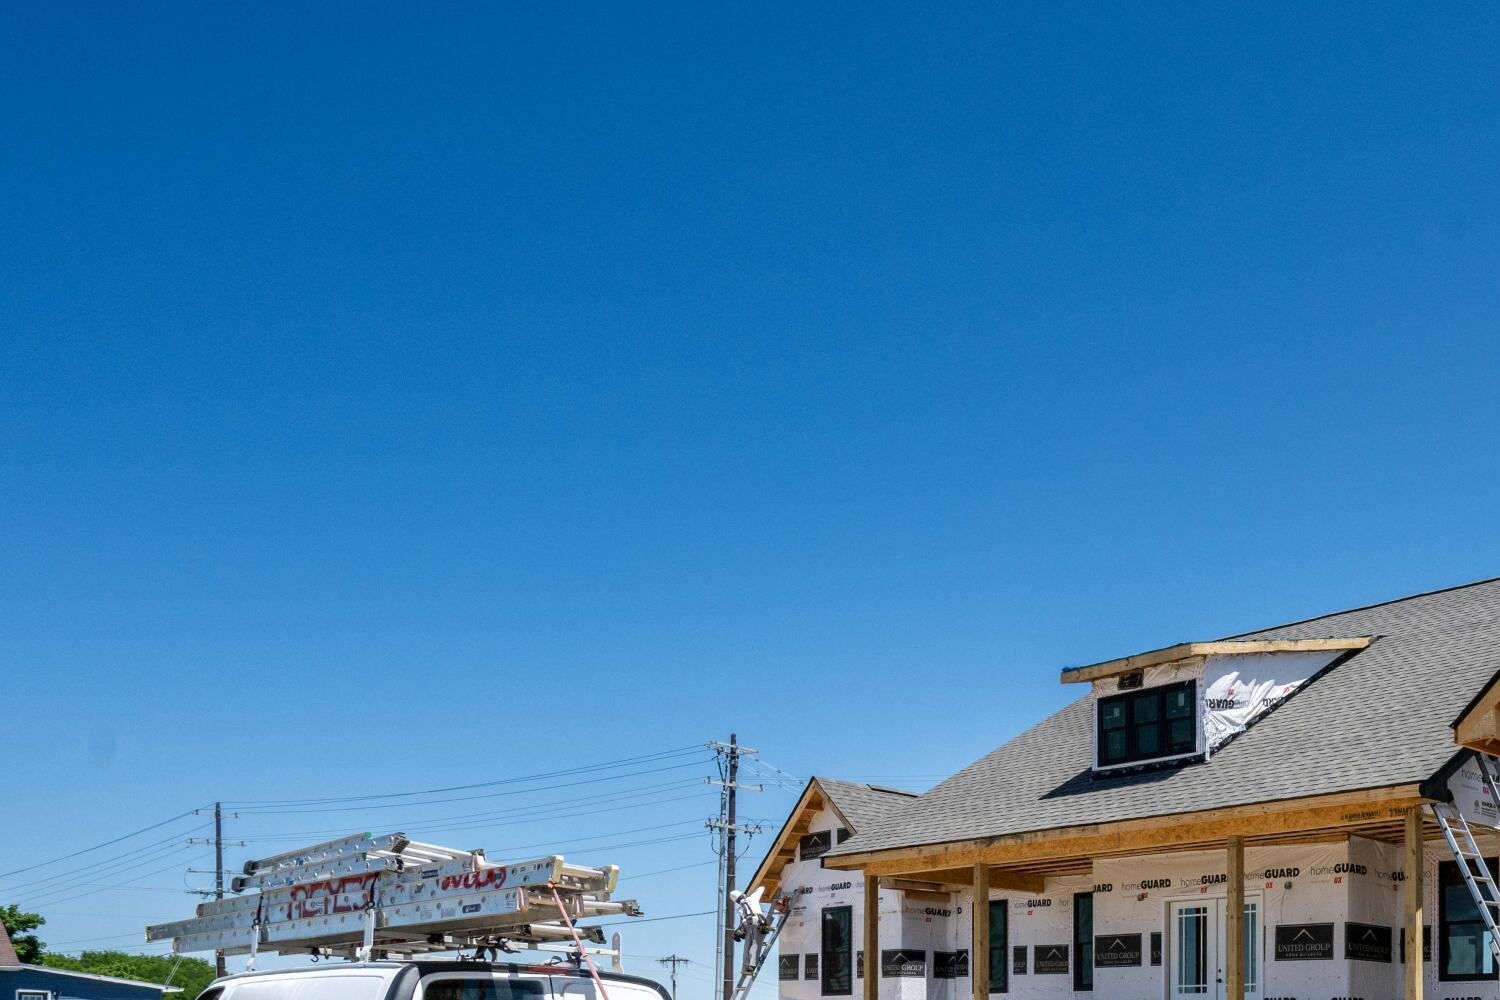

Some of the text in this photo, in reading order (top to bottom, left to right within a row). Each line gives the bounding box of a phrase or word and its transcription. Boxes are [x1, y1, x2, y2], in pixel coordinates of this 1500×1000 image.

[1310, 863, 1368, 876] homeGUARD
[1121, 878, 1172, 892] homeGUARD
[1333, 876, 1343, 885] OX
[1278, 943, 1331, 953] UNITED GROUP
[1119, 951, 1140, 961] GROUP
